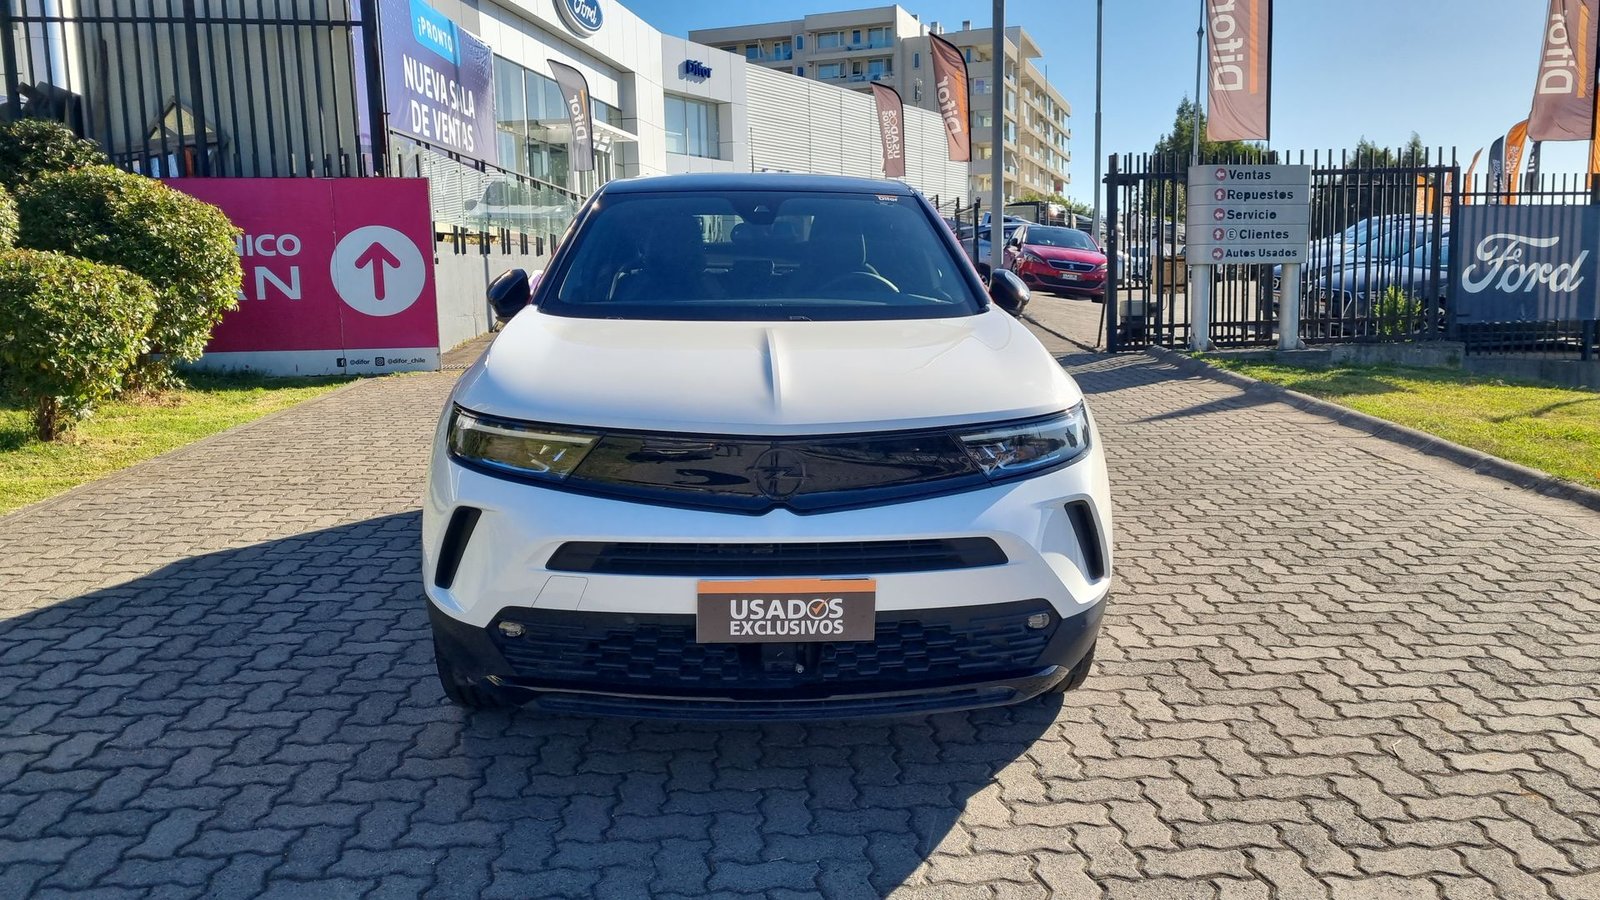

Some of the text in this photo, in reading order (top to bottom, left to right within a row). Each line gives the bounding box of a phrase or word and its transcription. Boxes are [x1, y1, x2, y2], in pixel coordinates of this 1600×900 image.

[403, 54, 476, 119] NUEVA SALA
[411, 100, 474, 153] DE VENTAS
[1228, 169, 1271, 180] Ventas
[1227, 189, 1294, 202] Repuestos
[1226, 209, 1277, 220] Servicio
[1239, 229, 1289, 239] Clientes
[1225, 248, 1297, 258] Autos Usados
[1461, 232, 1589, 294] Ford
[730, 597, 844, 620] USADOS
[730, 619, 844, 636] EXCLUSIVOS
